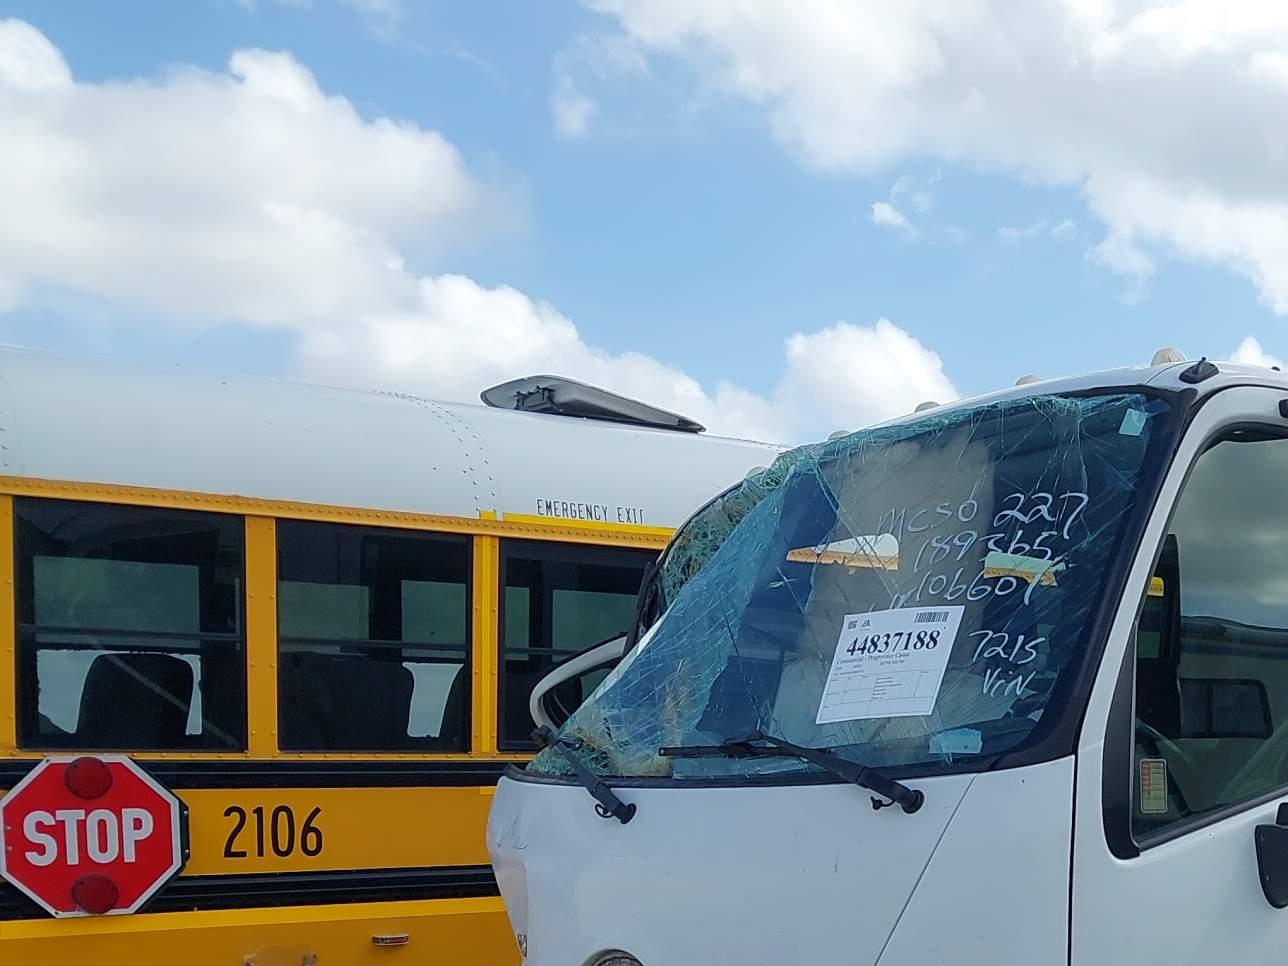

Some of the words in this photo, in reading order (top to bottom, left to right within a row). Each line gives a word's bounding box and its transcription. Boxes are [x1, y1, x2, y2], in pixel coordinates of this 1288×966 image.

[536, 499, 608, 522] EMERGENCY
[993, 492, 1089, 540] 227
[846, 630, 941, 656] 44837188
[969, 629, 1046, 666] 7215
[23, 808, 154, 867] STOP
[223, 805, 323, 859] 2106
